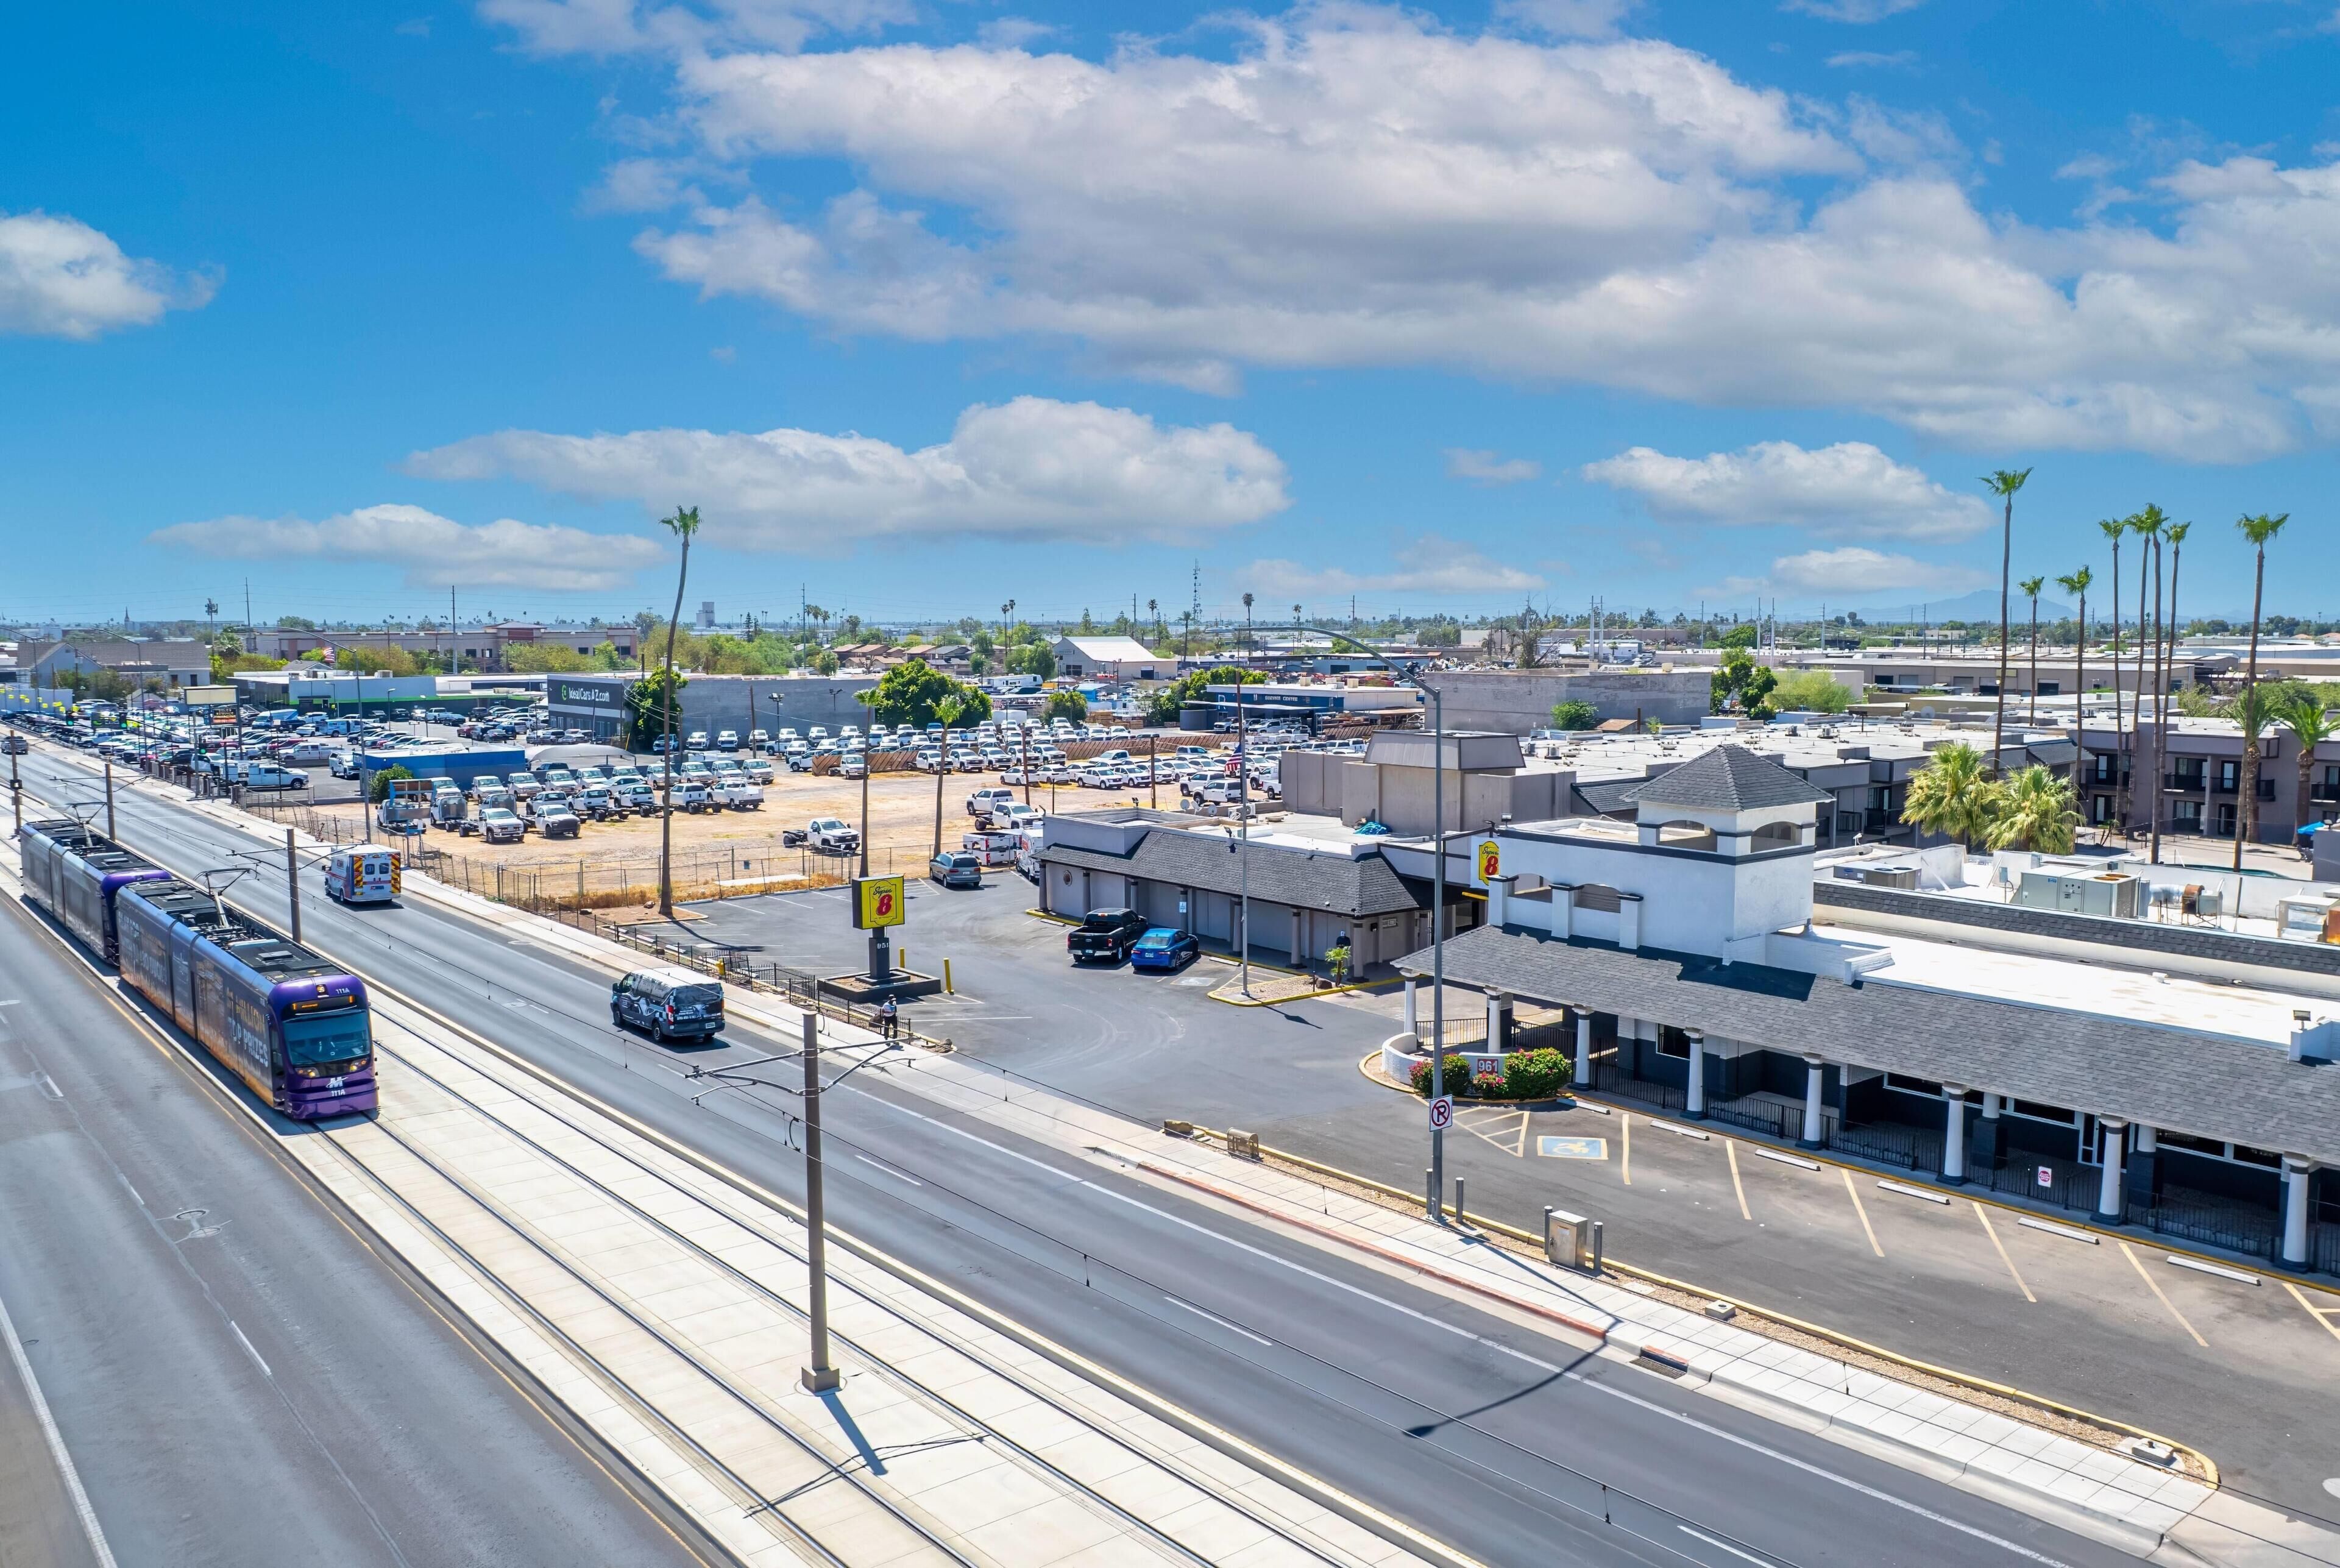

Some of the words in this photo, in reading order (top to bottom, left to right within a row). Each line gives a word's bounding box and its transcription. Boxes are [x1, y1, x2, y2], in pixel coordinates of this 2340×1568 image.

[1485, 856, 1498, 876] 8
[873, 886, 892, 898] Super
[876, 894, 893, 916] 8
[244, 1028, 268, 1067] PRIZES
[1478, 1060, 1497, 1071] 961
